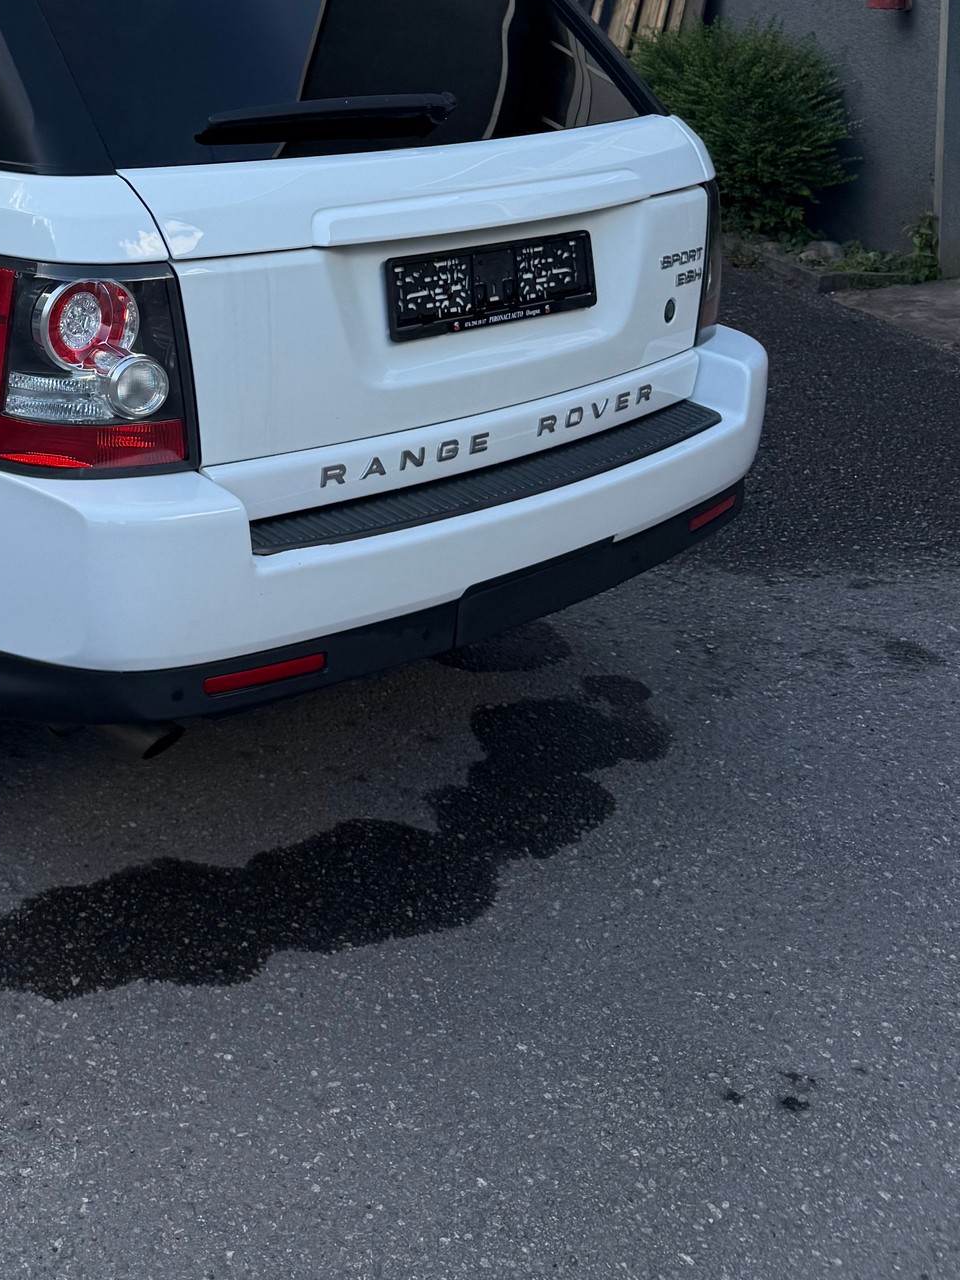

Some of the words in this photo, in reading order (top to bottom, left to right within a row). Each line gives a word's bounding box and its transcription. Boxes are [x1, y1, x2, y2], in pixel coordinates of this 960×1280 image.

[660, 246, 703, 270] SPORT
[320, 432, 489, 488] RANGE
[536, 383, 652, 437] ROVER
